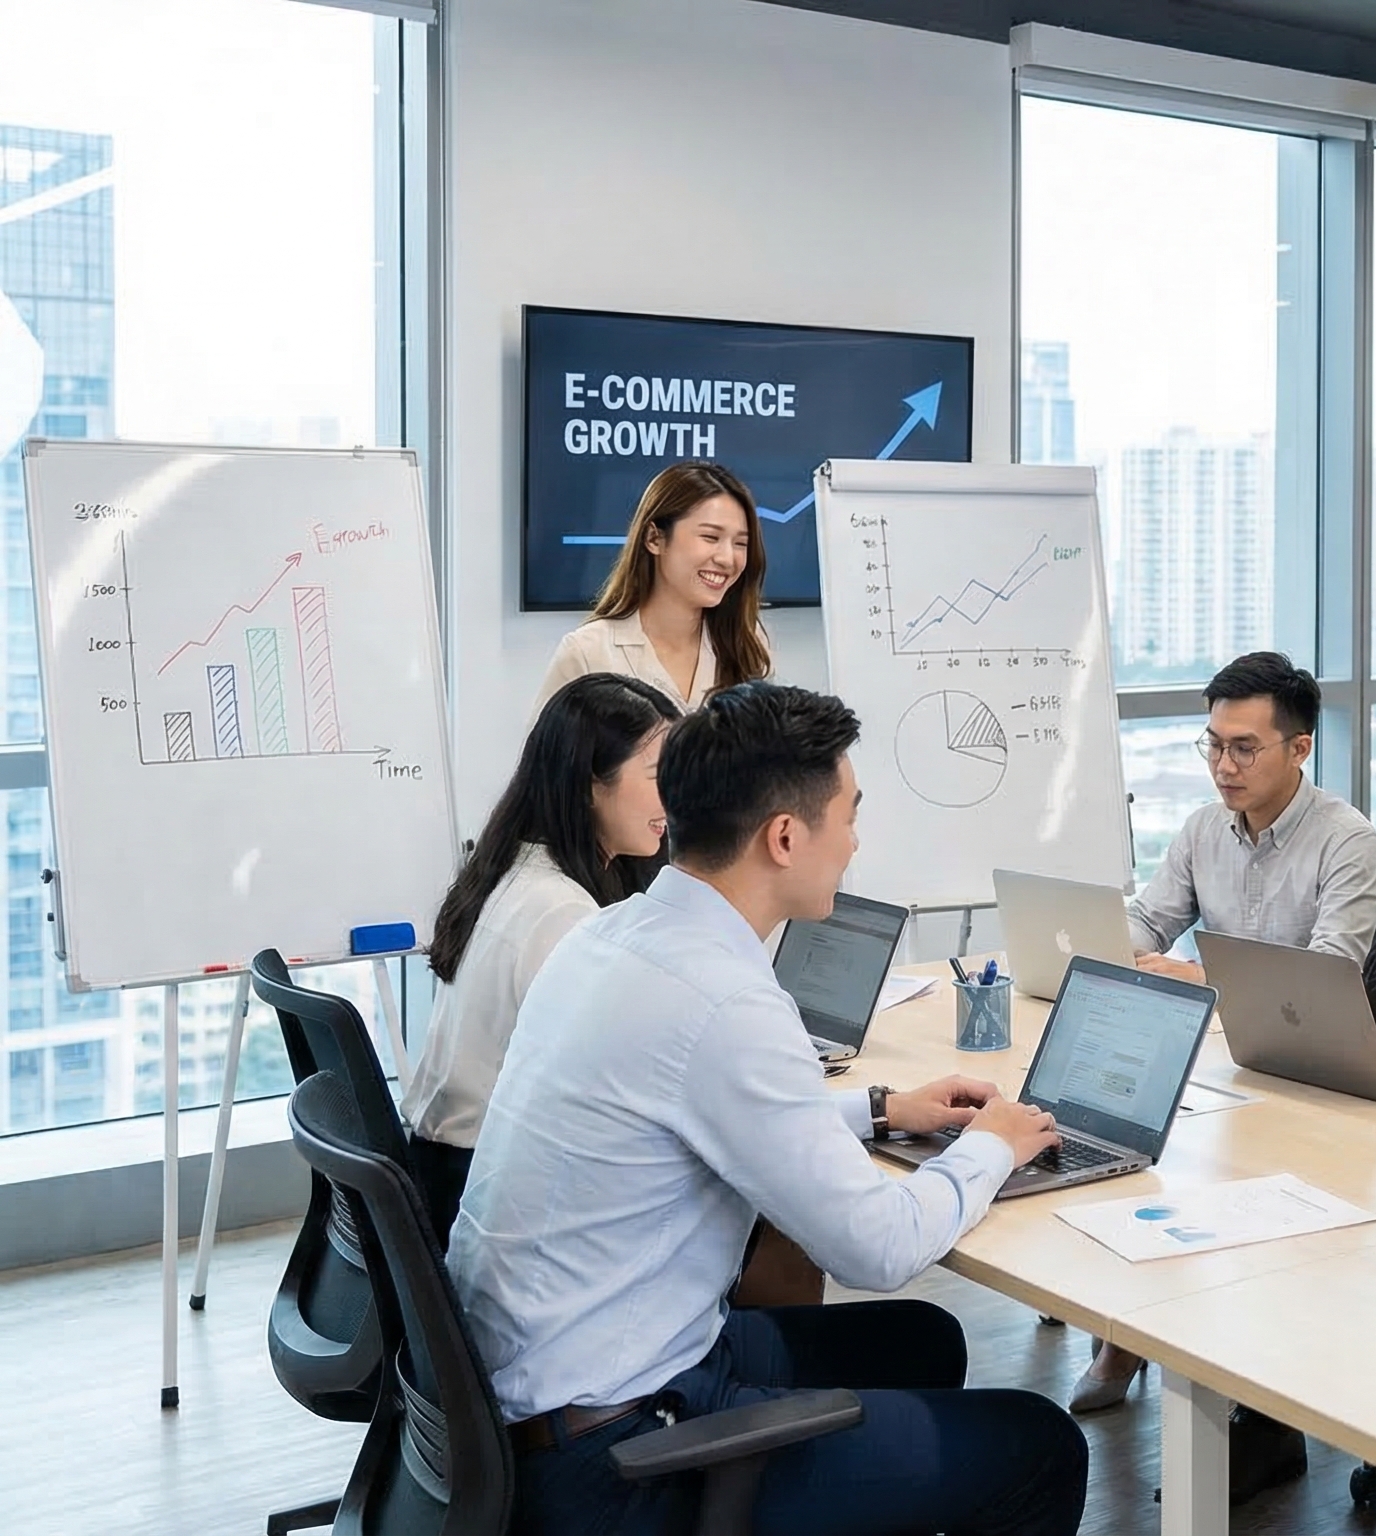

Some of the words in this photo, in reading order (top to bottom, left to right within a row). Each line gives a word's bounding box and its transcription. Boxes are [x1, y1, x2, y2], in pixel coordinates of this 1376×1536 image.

[565, 372, 796, 417] E-COMMERCE
[564, 418, 715, 458] GROWTH
[83, 583, 116, 599] 1500
[88, 636, 121, 652] 1000
[100, 696, 128, 713] 500
[372, 758, 423, 781] Time
